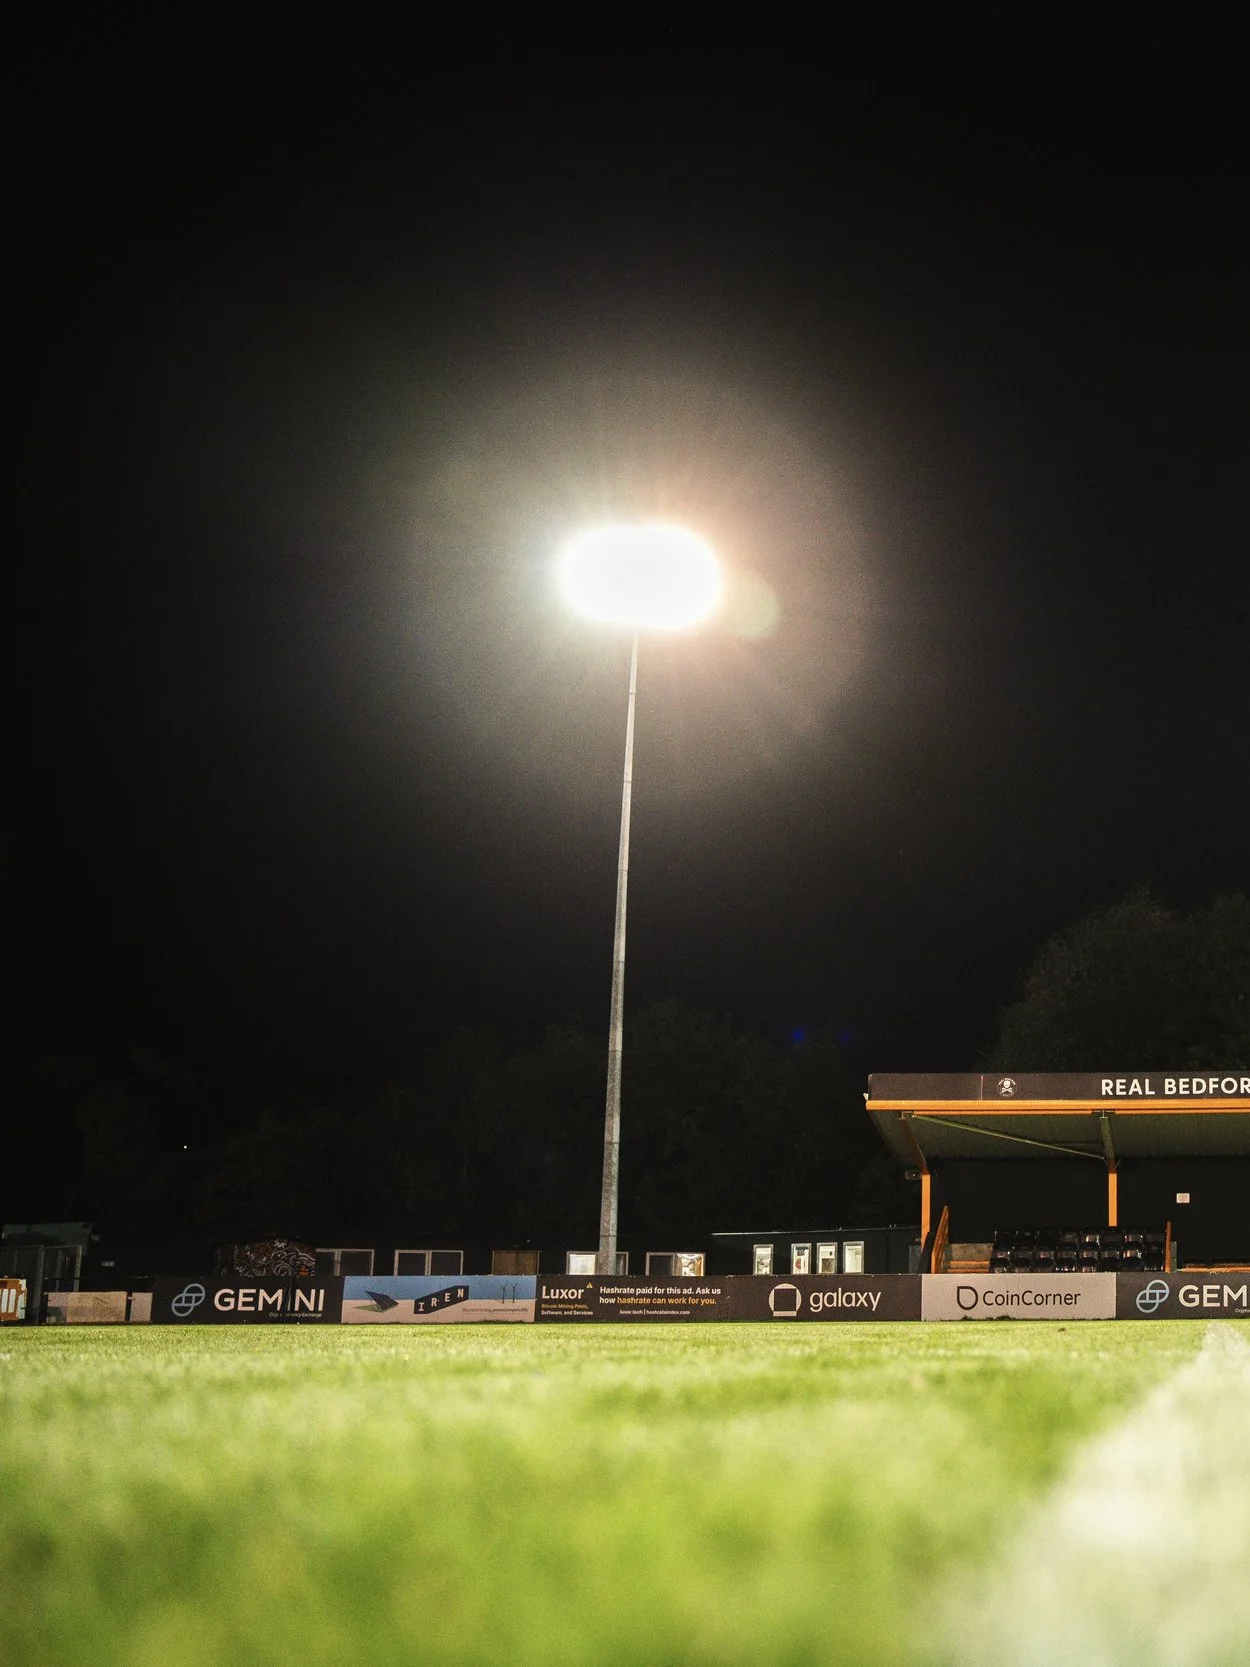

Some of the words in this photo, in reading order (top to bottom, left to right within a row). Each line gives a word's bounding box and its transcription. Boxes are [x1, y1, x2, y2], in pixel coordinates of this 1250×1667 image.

[1101, 1078, 1155, 1096] REAL
[541, 1285, 584, 1299] Luxor
[600, 1286, 635, 1294] Hashrate
[636, 1286, 653, 1296] paid
[654, 1286, 665, 1294] for
[666, 1286, 681, 1294] this
[695, 1287, 710, 1295] Ask
[809, 1287, 881, 1312] galaxy
[982, 1289, 1081, 1306] CoinCorner
[418, 1289, 464, 1312] IREN
[700, 1298, 717, 1306] you.
